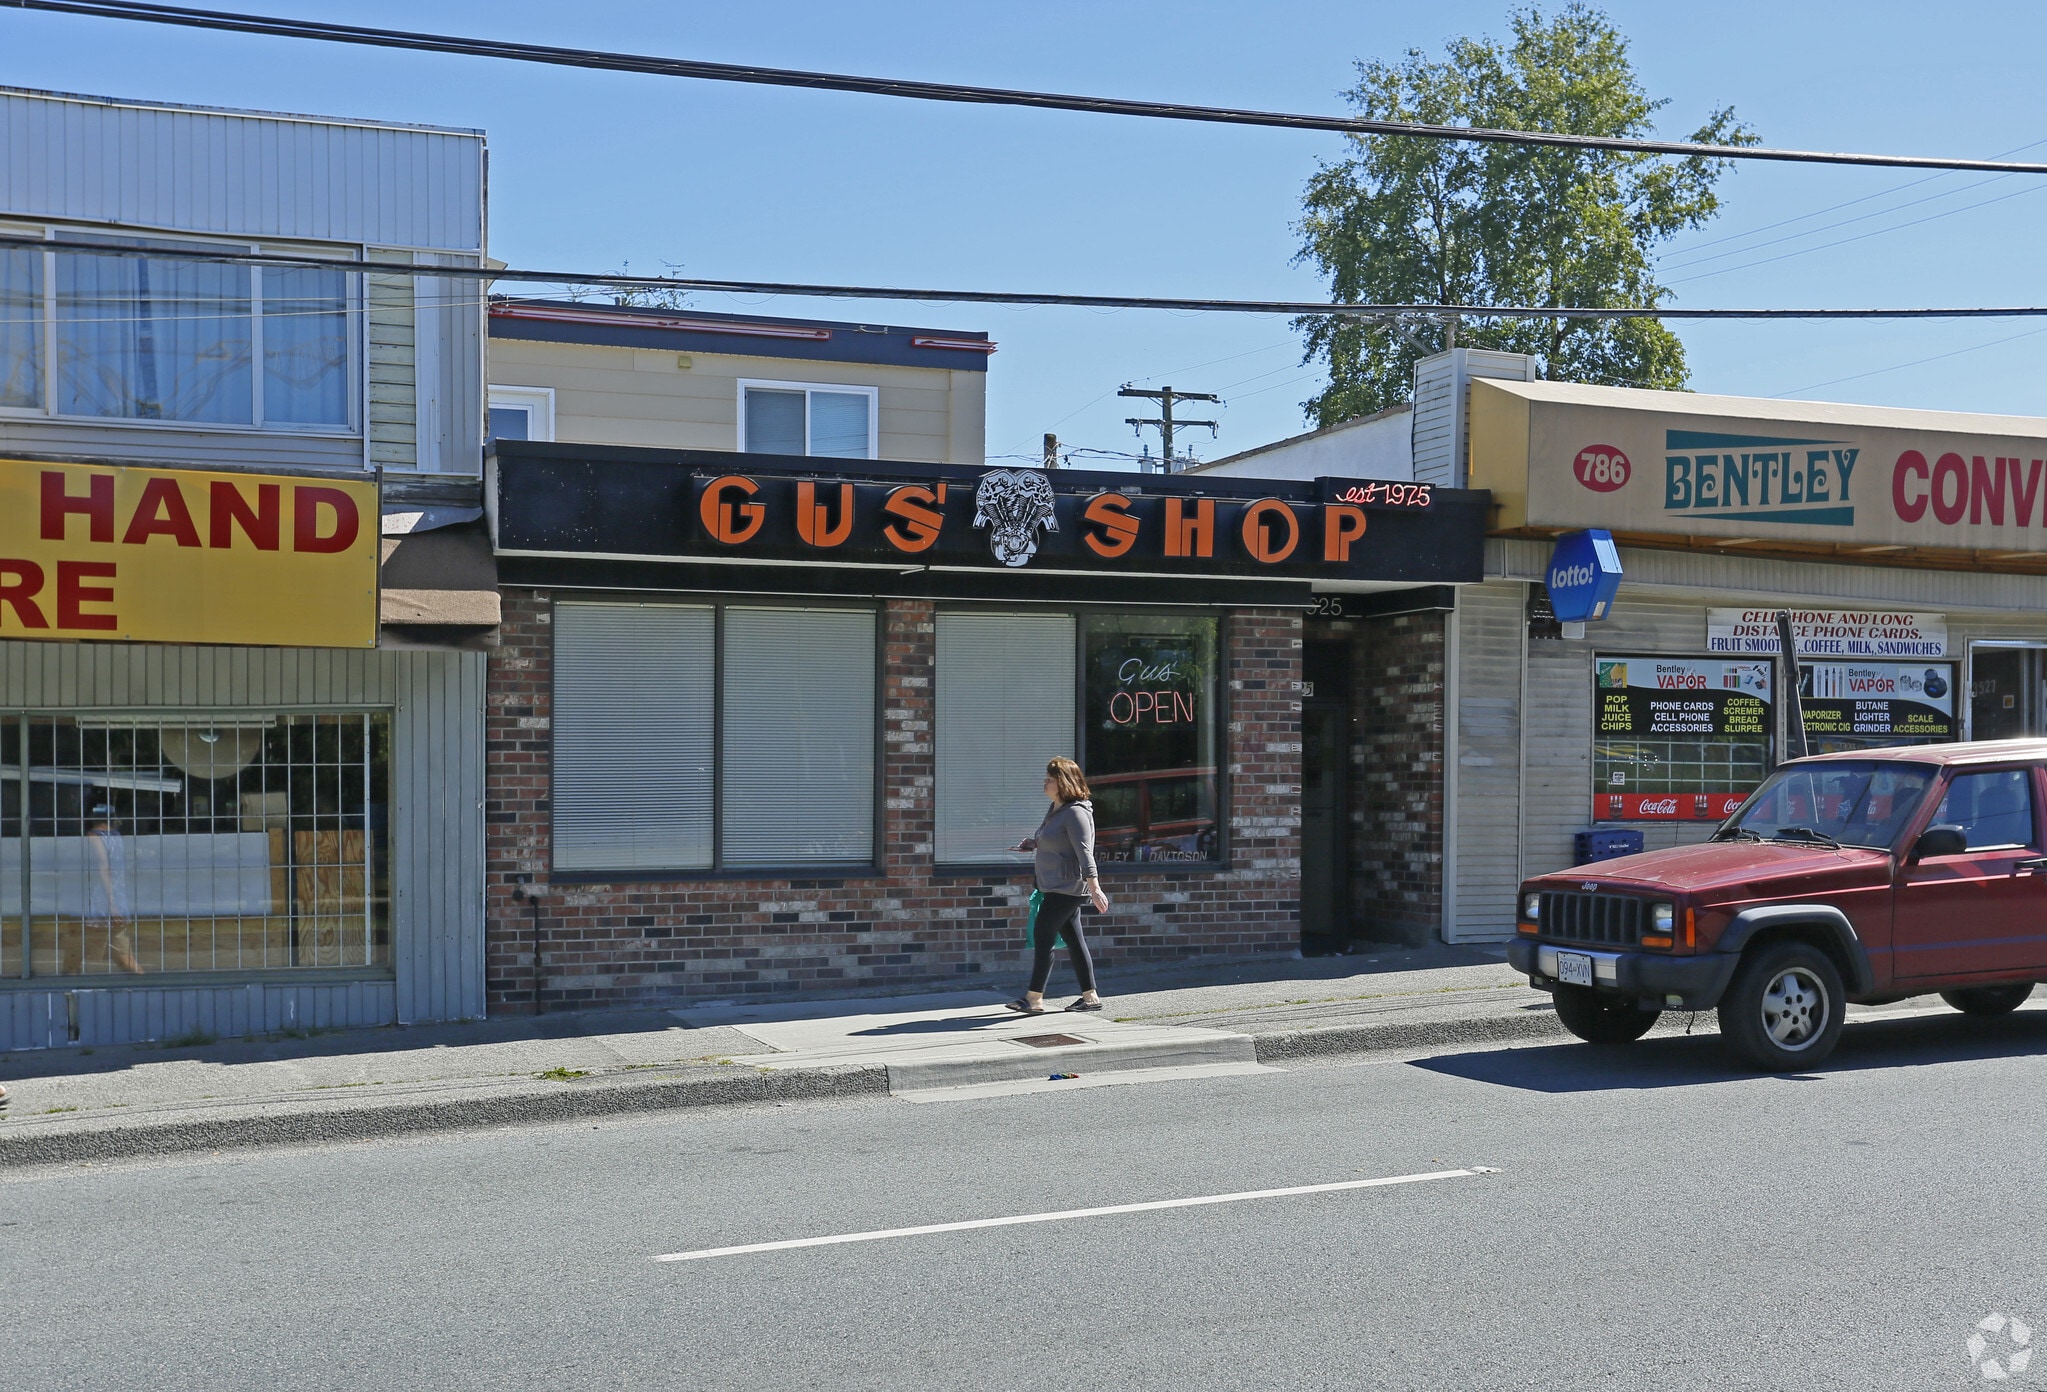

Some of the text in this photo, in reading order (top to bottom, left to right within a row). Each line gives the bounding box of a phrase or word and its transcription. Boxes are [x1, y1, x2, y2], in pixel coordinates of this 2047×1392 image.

[1580, 452, 1625, 484] 786
[1664, 448, 1861, 510] BENTLEY
[1892, 449, 2047, 528] CONV
[1384, 484, 1431, 507] 1975
[40, 471, 360, 553] HAND
[1083, 492, 1367, 564] SHOP
[1551, 562, 1594, 589] lotto!
[0, 558, 118, 631] RE
[1742, 611, 1914, 626] CELL HONE AND LONG
[1733, 625, 1923, 640] DISTACE PHONE CARDS.
[1711, 637, 1743, 651] FRUIT
[1656, 664, 1686, 675] Bentley
[1848, 668, 1877, 678] Bentley
[1656, 675, 1707, 690] VAPOR
[1849, 678, 1895, 693] VAPOR
[1606, 695, 1628, 704] POP
[1727, 698, 1760, 707] COFFEE
[1110, 691, 1194, 724] OPEN
[1604, 704, 1630, 713] MILK
[1650, 702, 1714, 711] PHONE CARDS
[1855, 701, 1889, 710] BUTANE
[1723, 707, 1764, 716] SCREMER
[1802, 710, 1842, 720] VAPORIZER
[1601, 713, 1632, 722] JUICE
[1654, 713, 1710, 722] CELL PHONE
[1729, 716, 1758, 724] BREAD
[1854, 713, 1890, 722] LIGHTER
[1907, 714, 1934, 723] SCALE
[1601, 722, 1632, 731] CHIPS
[1650, 723, 1714, 732] ACCESSORIES
[1724, 725, 1763, 733] SLURPEE
[1838, 722, 1851, 732] CIG
[1853, 723, 1891, 733] GRINDER
[1893, 725, 1948, 733] ACCESSORIES
[1639, 798, 1678, 815] Coca-Cola
[1149, 851, 1208, 862] DAVIDSON
[1581, 881, 1598, 892] Jeep
